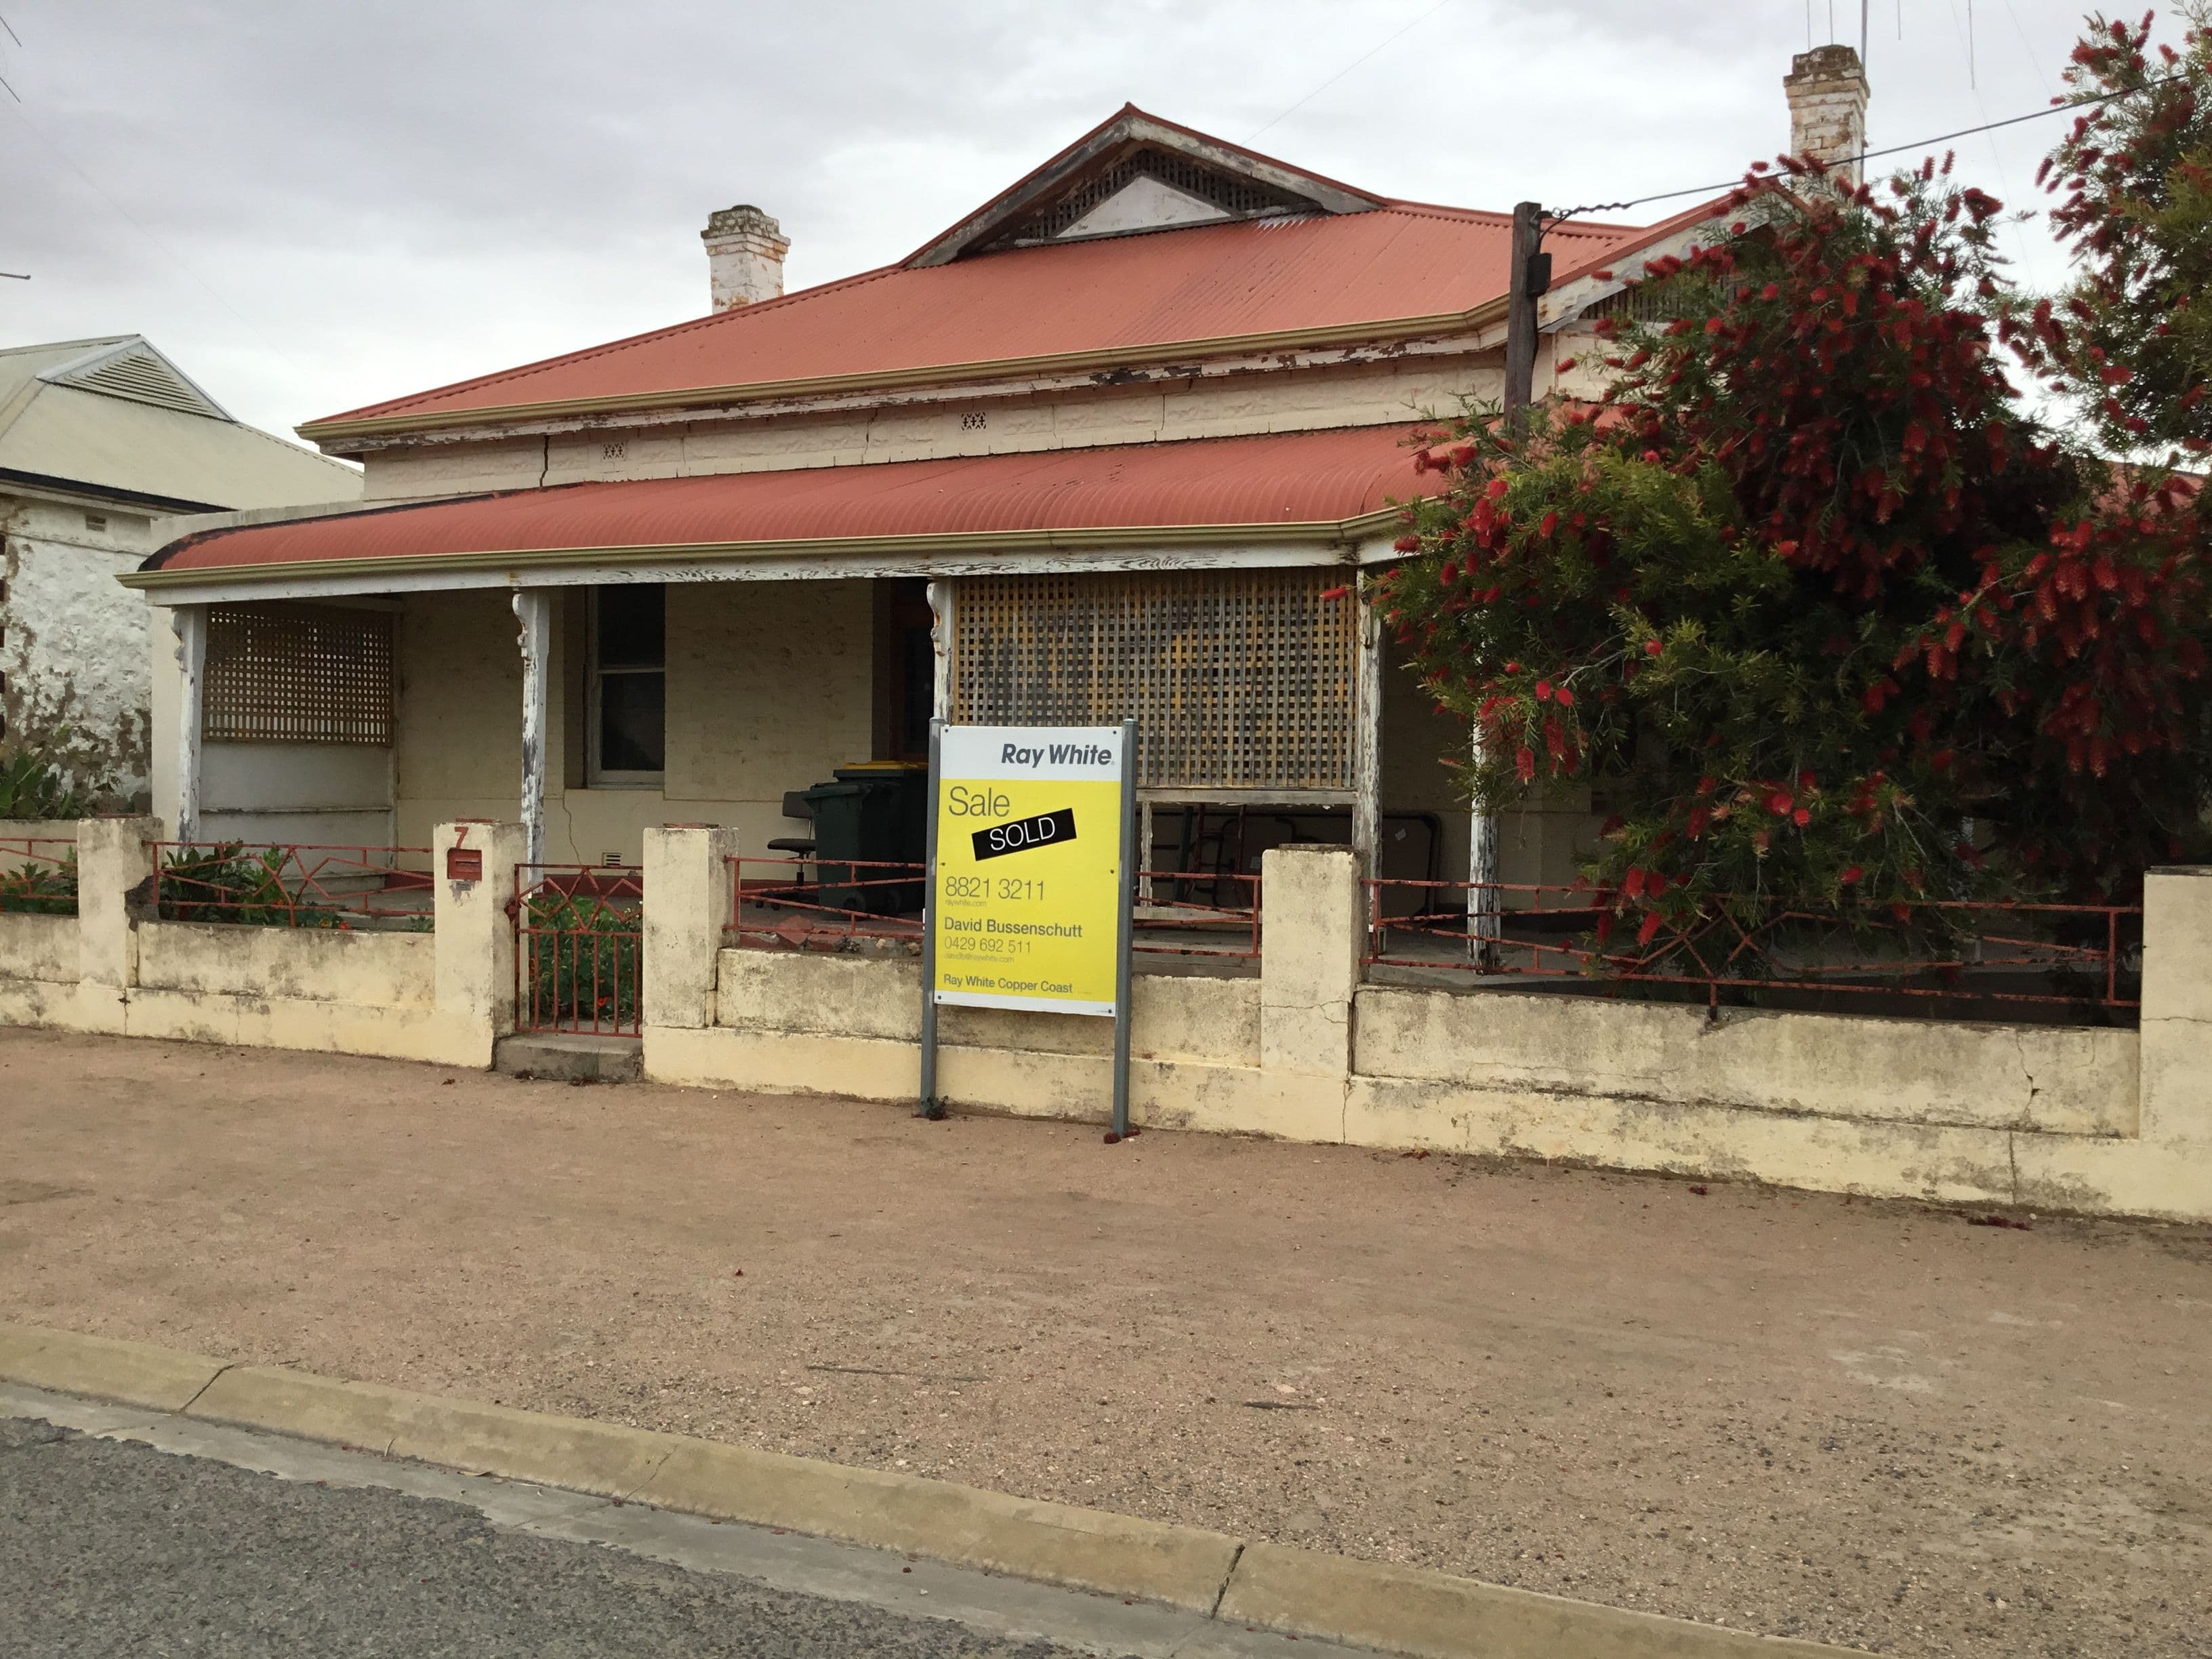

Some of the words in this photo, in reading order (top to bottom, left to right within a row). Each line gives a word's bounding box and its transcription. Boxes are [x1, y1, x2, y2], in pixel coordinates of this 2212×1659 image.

[1001, 743, 1044, 768] Ray
[1049, 744, 1112, 765] White
[949, 786, 1010, 817] Sale
[454, 826, 469, 849] 7
[989, 817, 1056, 851] SOLD
[945, 876, 989, 898] 8821
[998, 878, 1044, 901] 3211
[944, 917, 982, 932] David
[987, 919, 1082, 937] Bussenschutt
[944, 937, 976, 950] 0429
[980, 939, 1003, 952] 692
[1008, 940, 1031, 954] 511
[944, 974, 963, 987] Ray
[966, 976, 995, 988] White
[998, 978, 1038, 992] Copper
[1041, 981, 1073, 994] Coast
